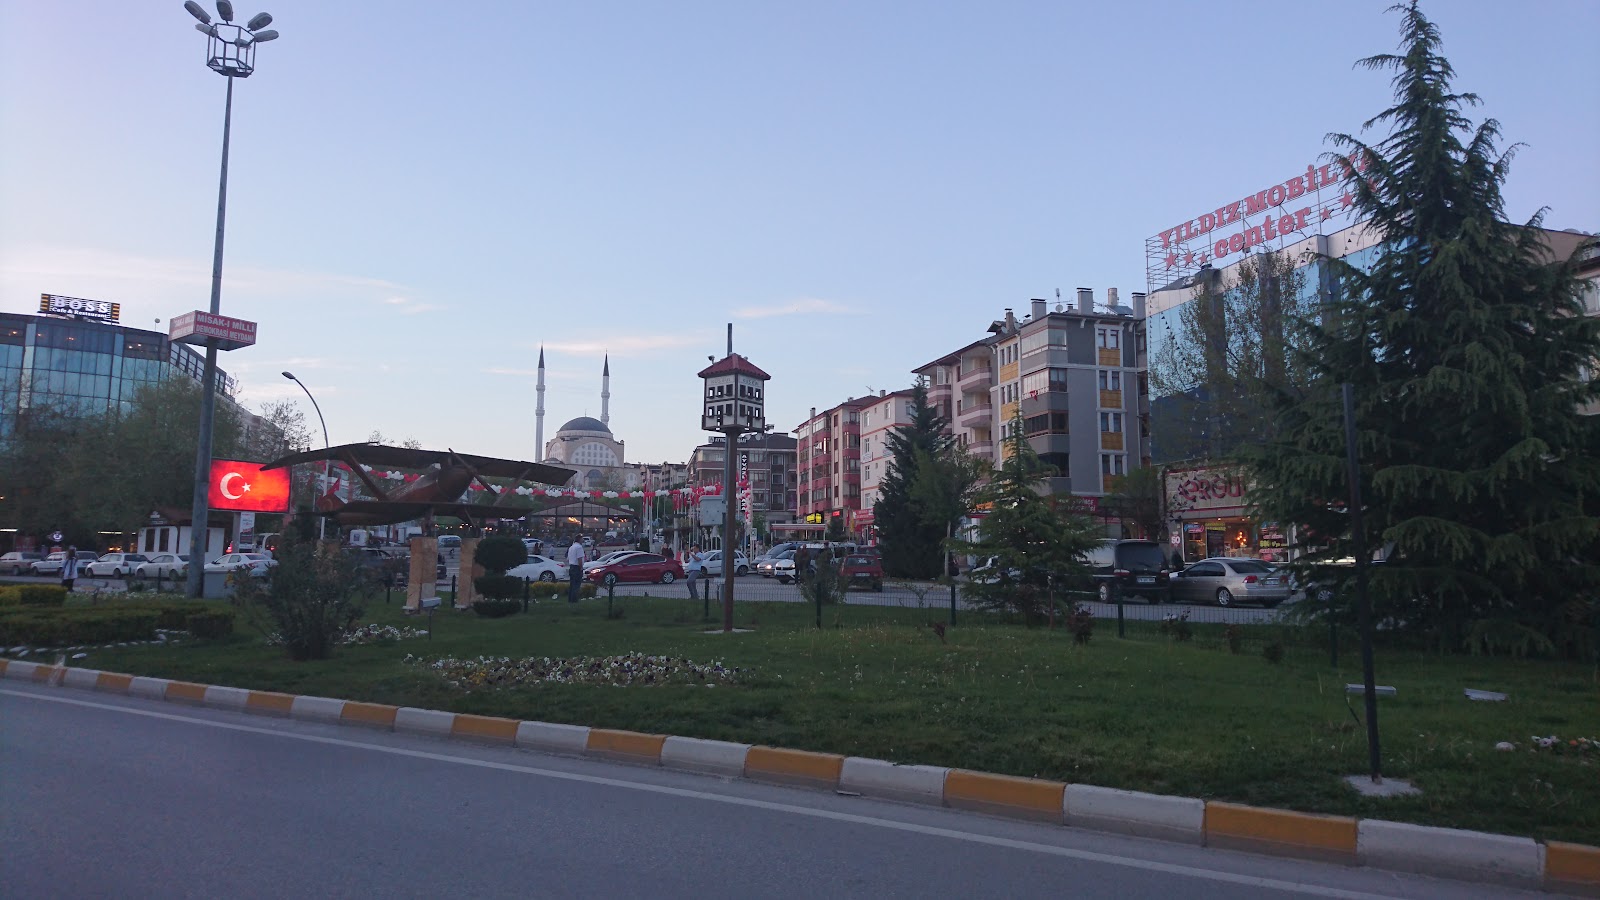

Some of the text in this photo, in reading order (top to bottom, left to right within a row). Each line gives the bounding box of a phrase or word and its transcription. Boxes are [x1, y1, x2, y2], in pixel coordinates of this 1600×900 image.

[1158, 201, 1242, 249] YILDIZ
[1213, 206, 1312, 259] center
[53, 296, 109, 314] BOSS
[195, 324, 229, 338] DEMOKRASİ
[229, 330, 255, 342] MEYDANI
[196, 314, 255, 333] MİSAK-I MİLLİ
